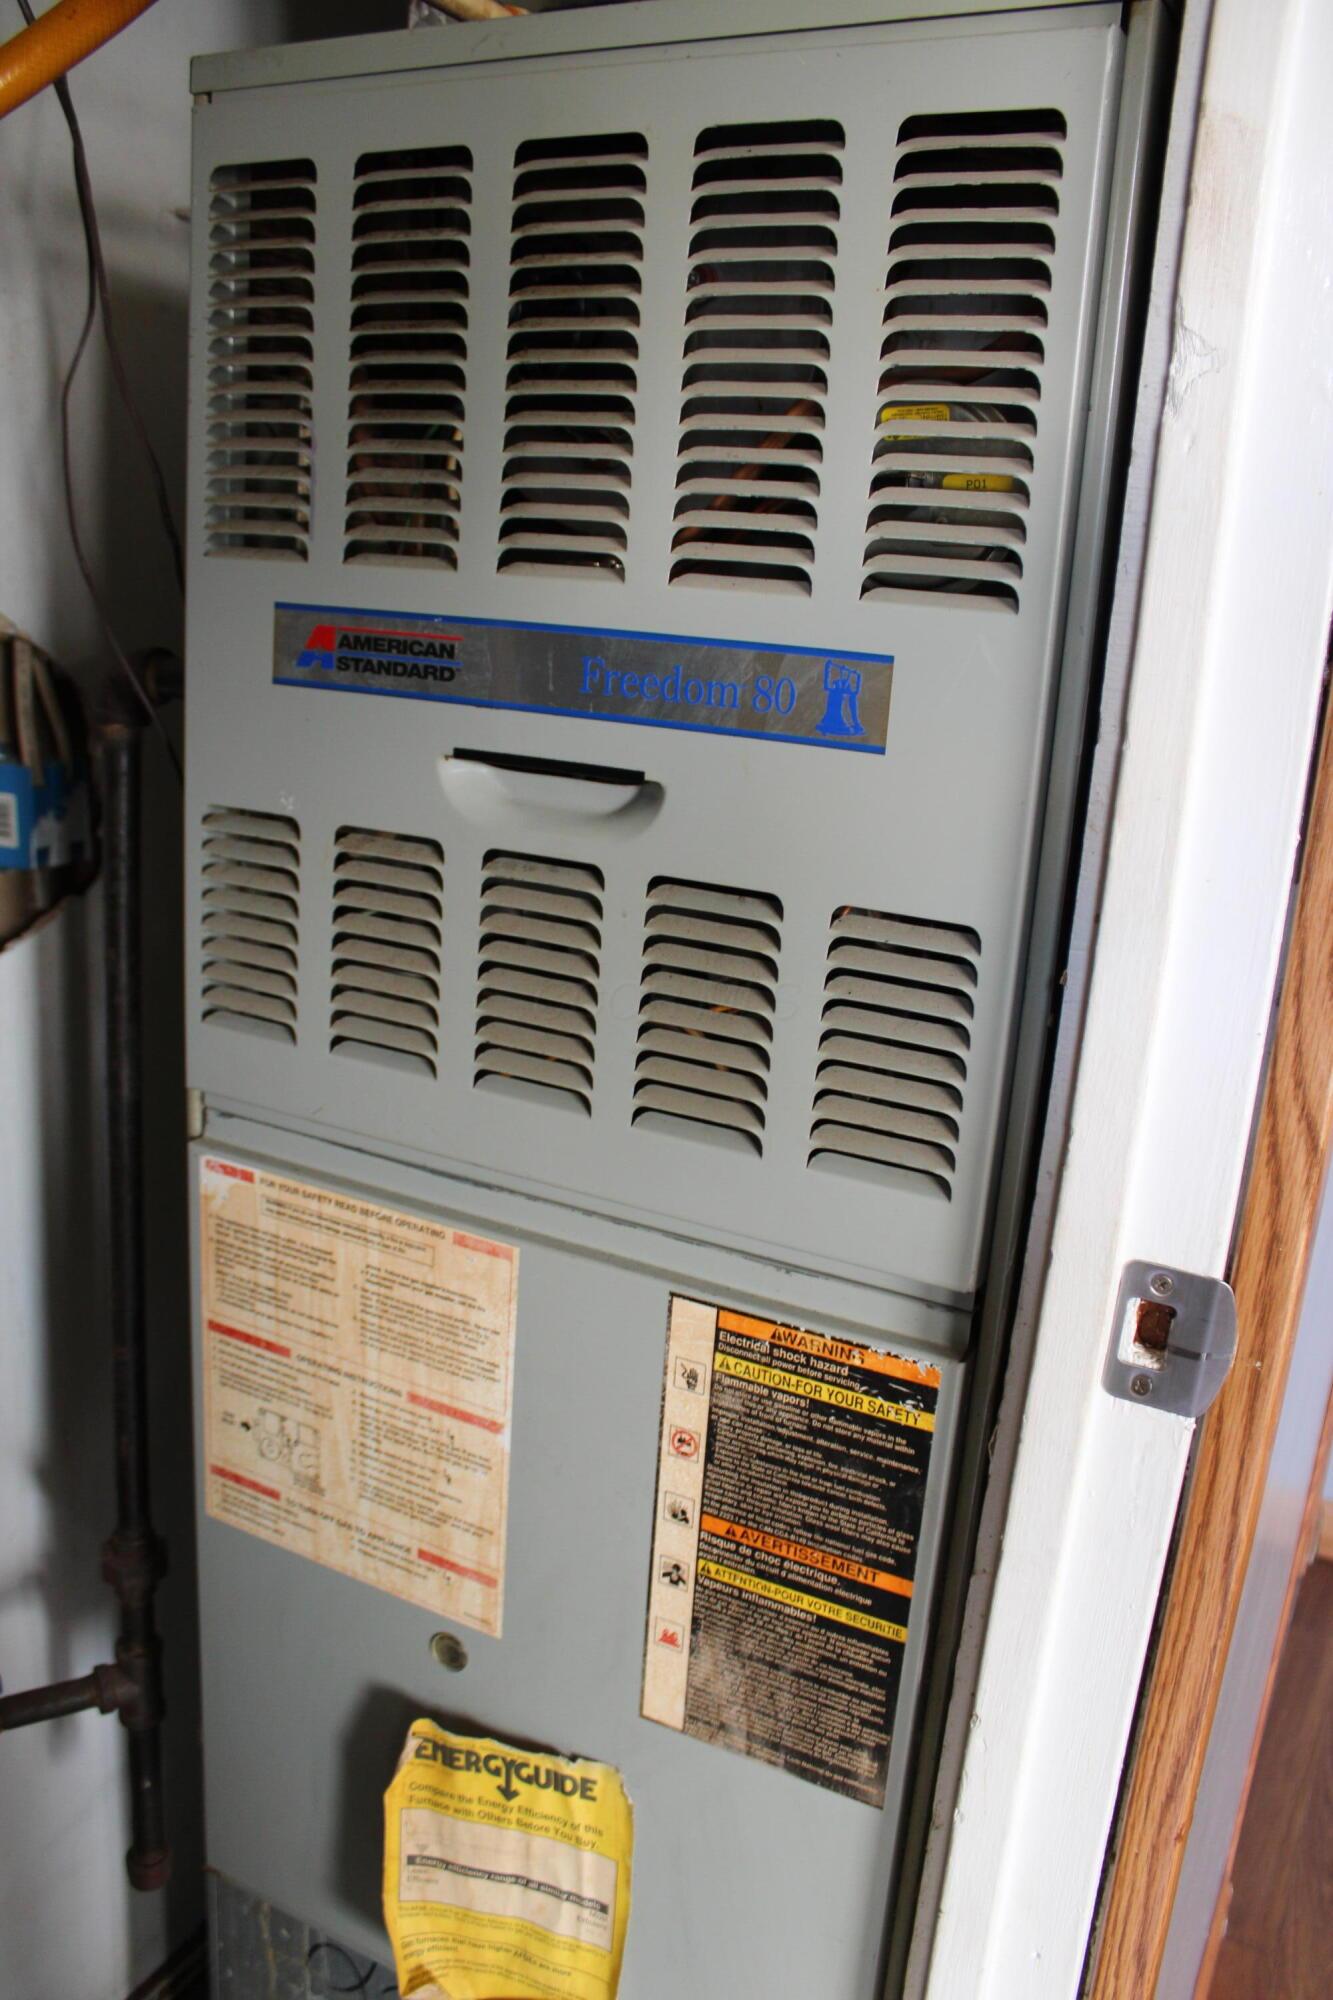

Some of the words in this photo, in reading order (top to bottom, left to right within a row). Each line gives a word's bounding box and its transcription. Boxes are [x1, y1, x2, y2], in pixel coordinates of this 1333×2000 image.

[338, 633, 455, 660] AMERICAN
[336, 655, 456, 682] STANDARD
[579, 655, 741, 709] Freedom
[752, 674, 797, 716] 80
[278, 1182, 299, 1196] YOUR
[302, 1189, 331, 1205] SAFETY
[335, 1199, 356, 1213] READ
[359, 1207, 391, 1224] BEFORE
[394, 1217, 445, 1240] OPERATING
[718, 1342, 761, 1361] Disconnect
[772, 1358, 795, 1371] power
[797, 1364, 822, 1378] before
[719, 1330, 770, 1354] Electrical
[772, 1345, 806, 1364] shock
[809, 1356, 848, 1376] hazard
[715, 1372, 769, 1396] Flammable
[771, 1389, 809, 1409] vapors!
[826, 1388, 863, 1410] YOUR
[867, 1399, 920, 1426] SAFETY
[700, 1531, 736, 1553] Risque
[738, 1543, 752, 1556] de
[754, 1548, 781, 1566] choc
[739, 1527, 879, 1583] AVERTISSEMENT
[697, 1574, 739, 1599] Vapeurs
[806, 1597, 842, 1618] VOTRE
[478, 1796, 514, 1814] Energy
